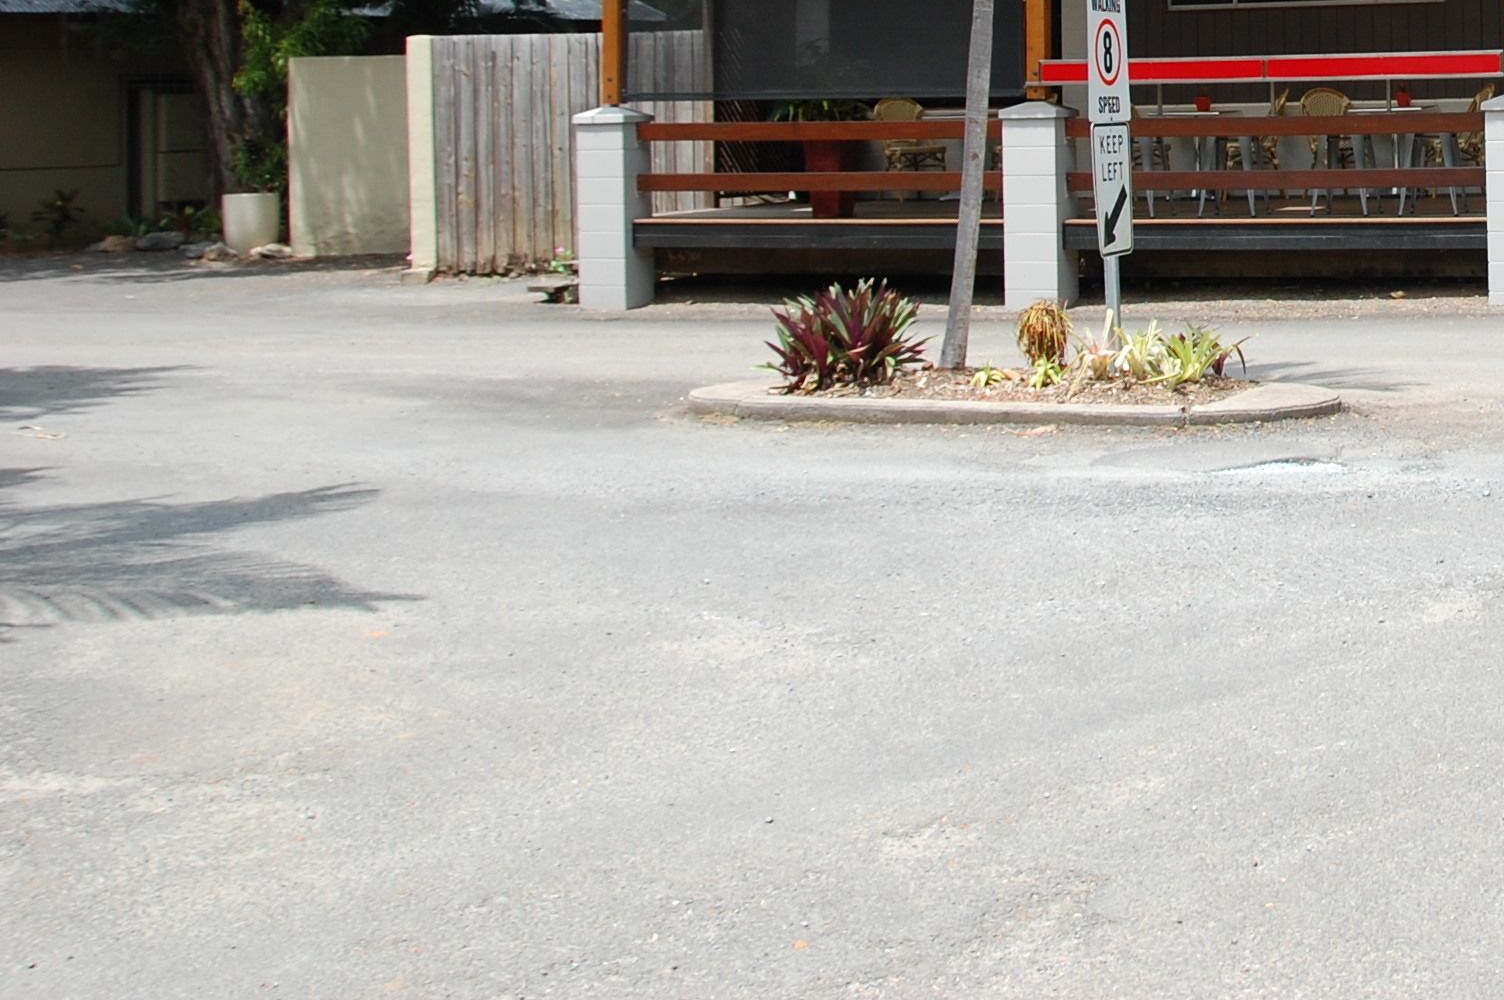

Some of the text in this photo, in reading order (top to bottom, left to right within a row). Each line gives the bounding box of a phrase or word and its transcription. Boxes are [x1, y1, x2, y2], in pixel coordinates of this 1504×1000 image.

[1103, 31, 1112, 74] 8
[1098, 96, 1121, 114] SPEED
[1098, 134, 1124, 155] KEEP
[1102, 162, 1124, 182] LEFT
